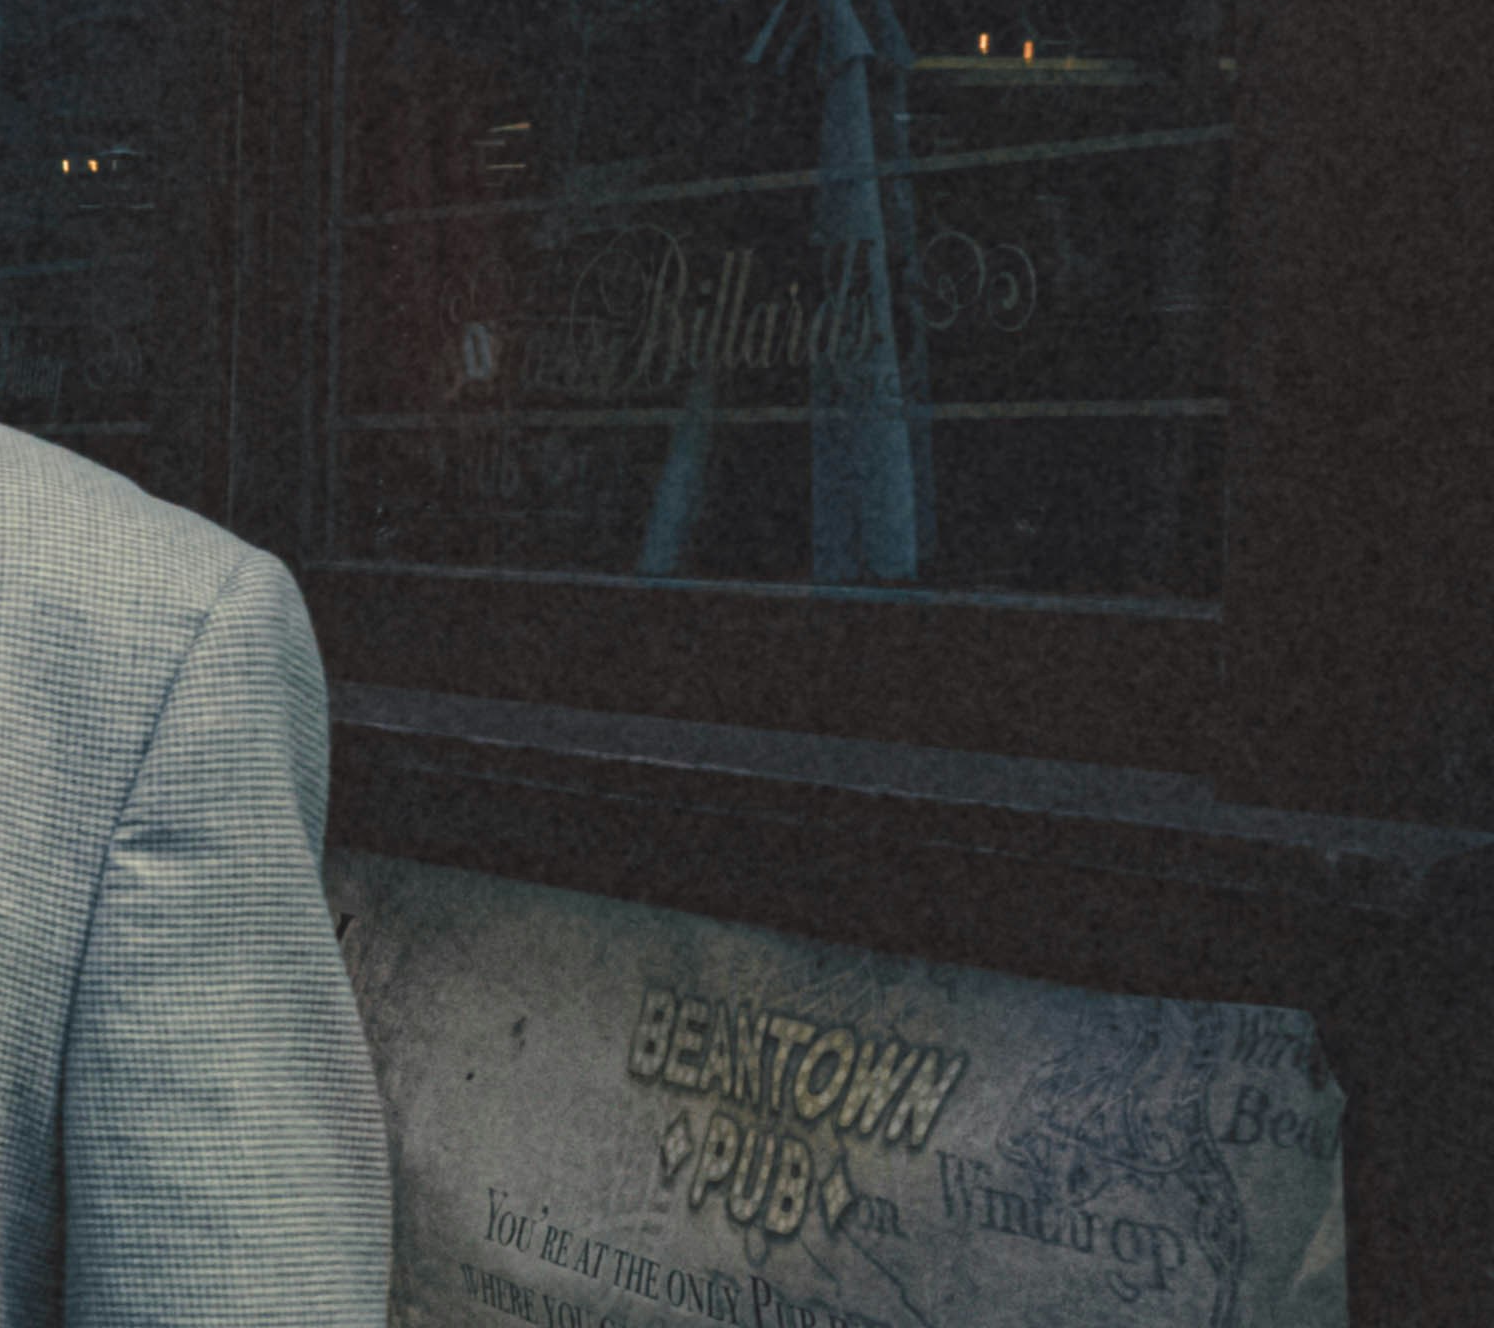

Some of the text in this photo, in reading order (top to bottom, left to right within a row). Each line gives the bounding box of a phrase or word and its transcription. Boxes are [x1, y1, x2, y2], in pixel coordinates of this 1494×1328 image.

[628, 988, 970, 1155] BEANTOWN
[689, 1110, 815, 1245] PUB
[461, 1262, 535, 1324] WHERE
[484, 1187, 571, 1266] YOU'RE
[574, 1237, 609, 1280] AT
[613, 1249, 662, 1301] THE
[665, 1267, 741, 1325] ONLY
